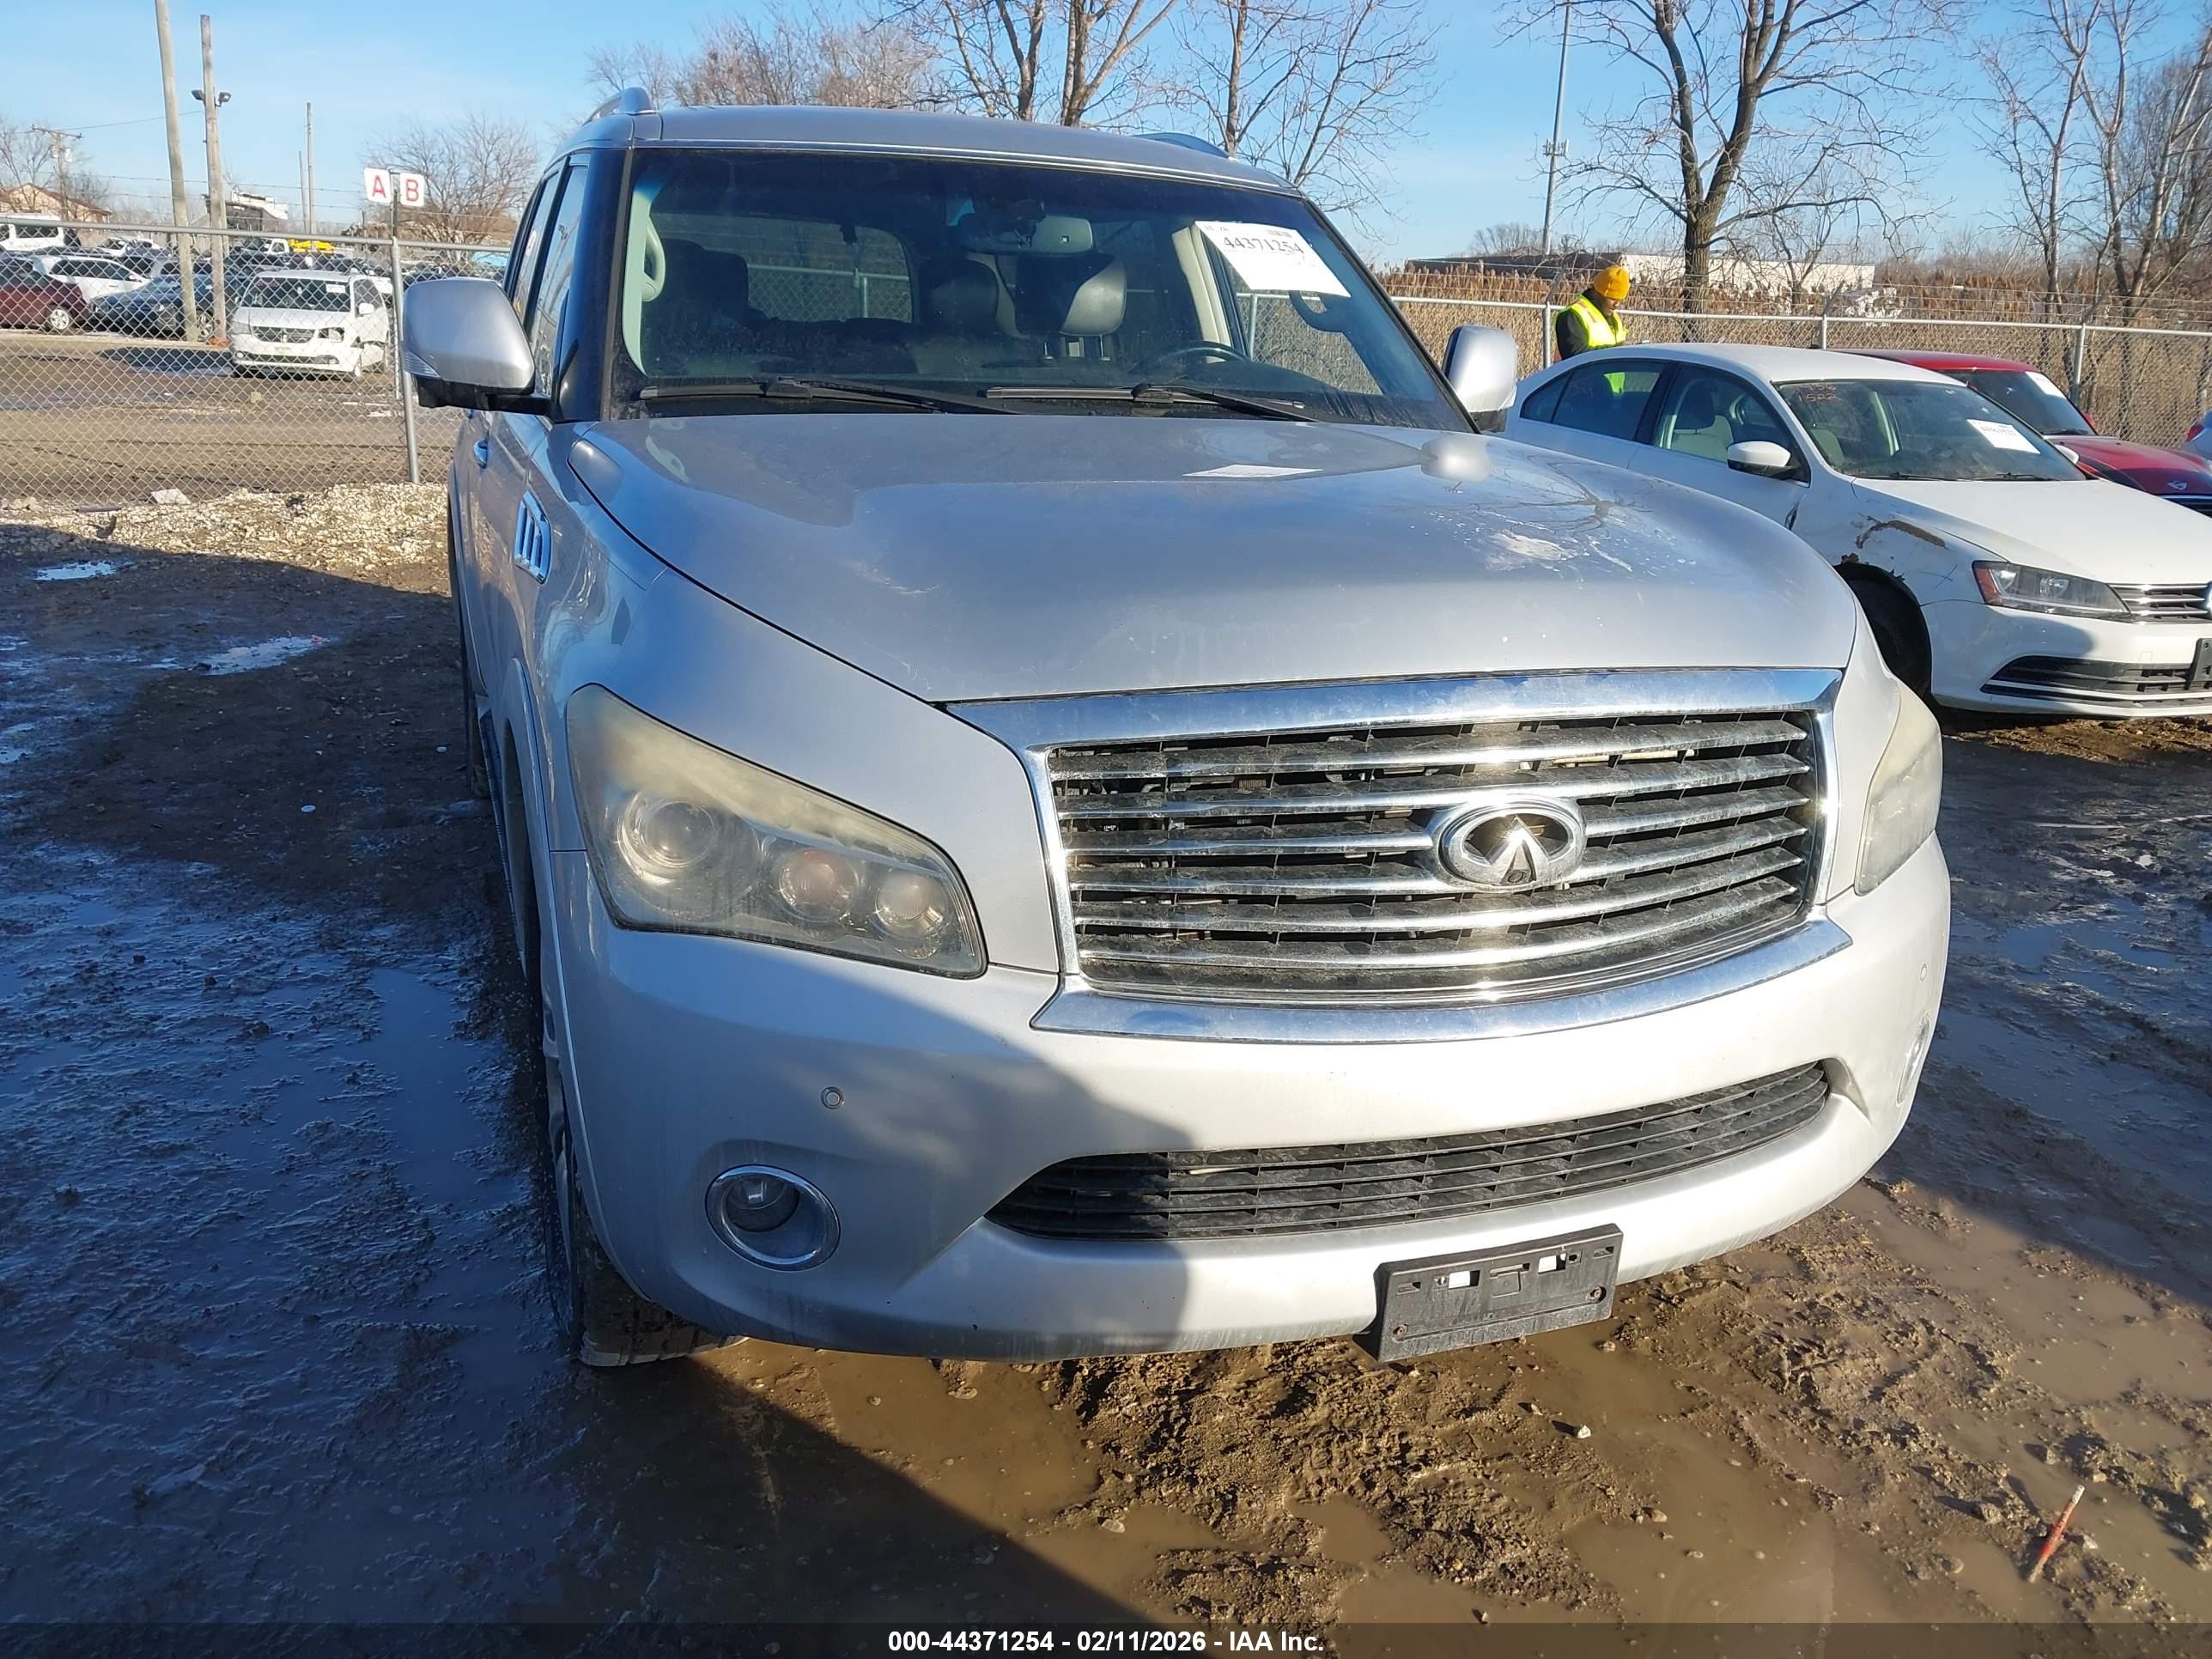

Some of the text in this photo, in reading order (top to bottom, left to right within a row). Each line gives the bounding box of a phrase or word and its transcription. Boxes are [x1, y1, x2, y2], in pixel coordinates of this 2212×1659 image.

[372, 175, 386, 198] A
[405, 179, 420, 202] B
[1224, 236, 1304, 255] 44371254
